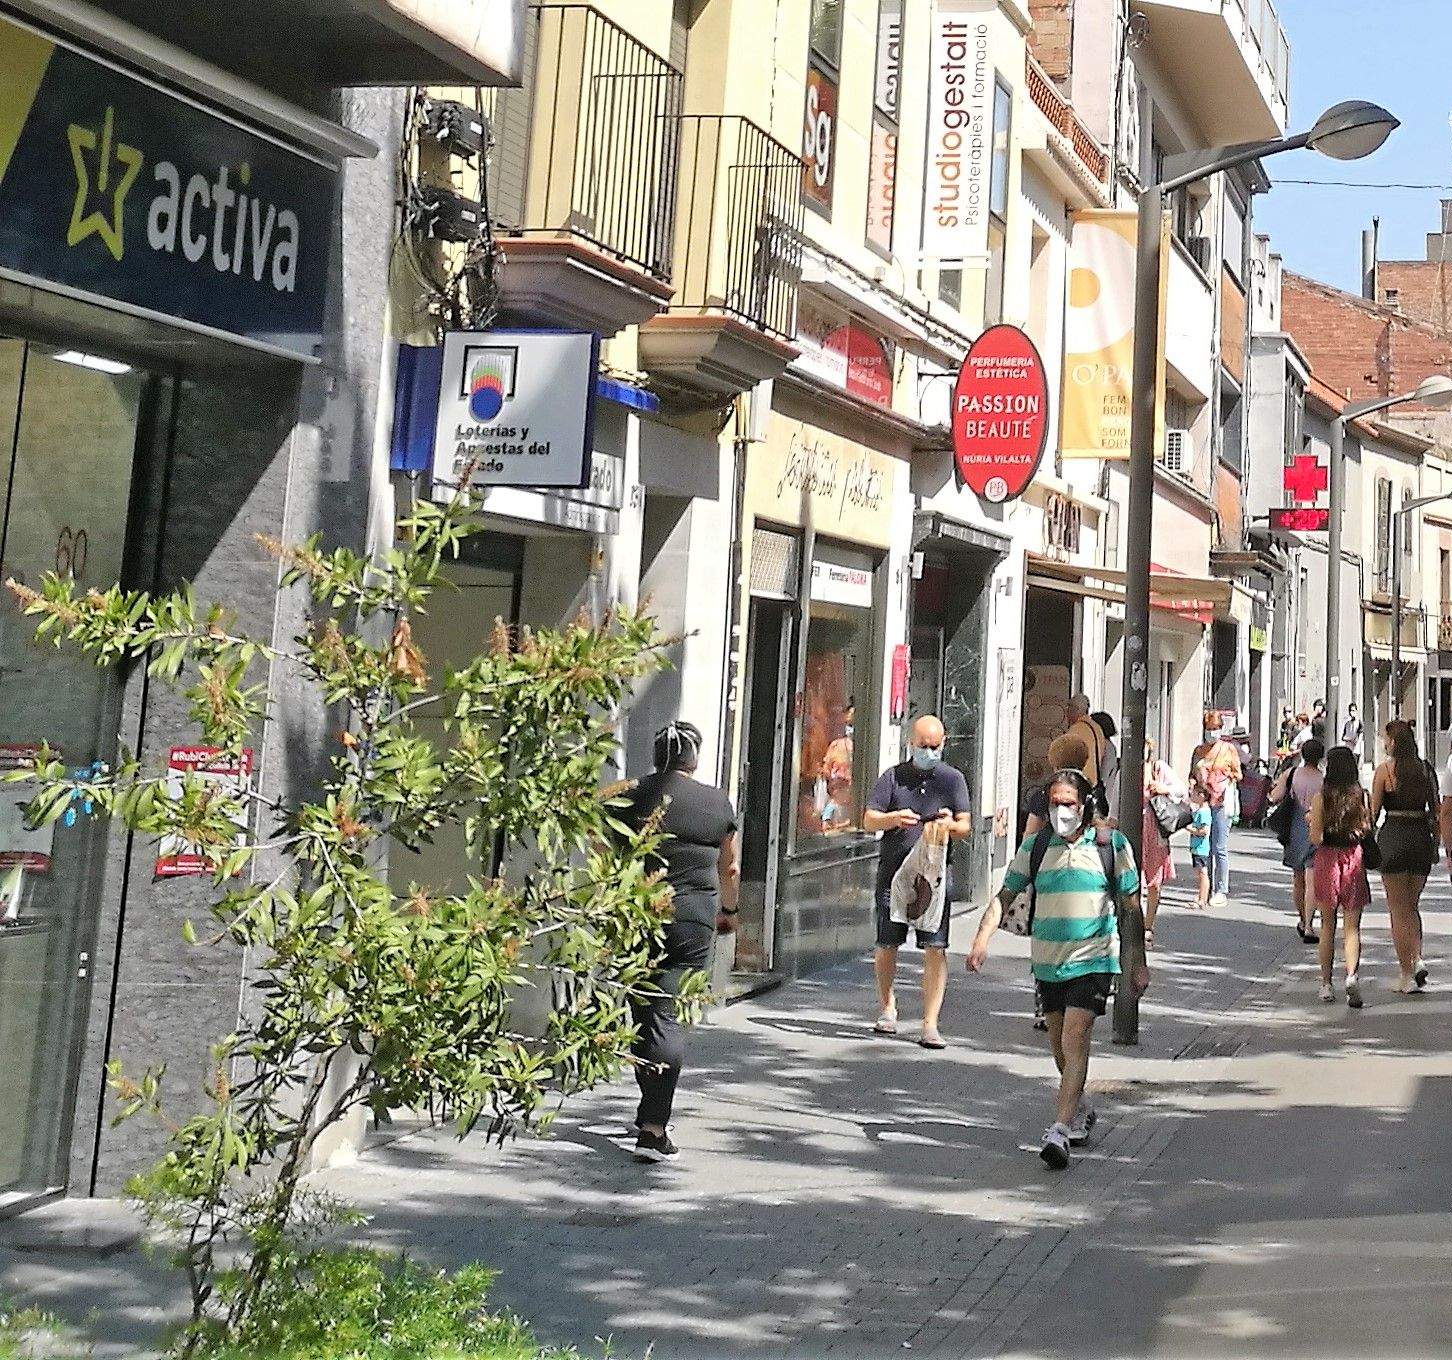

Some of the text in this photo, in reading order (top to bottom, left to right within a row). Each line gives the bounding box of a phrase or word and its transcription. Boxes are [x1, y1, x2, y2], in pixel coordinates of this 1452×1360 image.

[971, 23, 989, 99] formació
[932, 21, 971, 228] studiogestalt
[147, 160, 300, 293] activa
[957, 394, 1040, 414] PASSION
[1102, 405, 1127, 416] BON
[456, 423, 530, 441] Loterías y
[965, 416, 1038, 439] BEAUTÉ
[454, 441, 551, 457] Apestas del
[994, 454, 1032, 465] VILALTA
